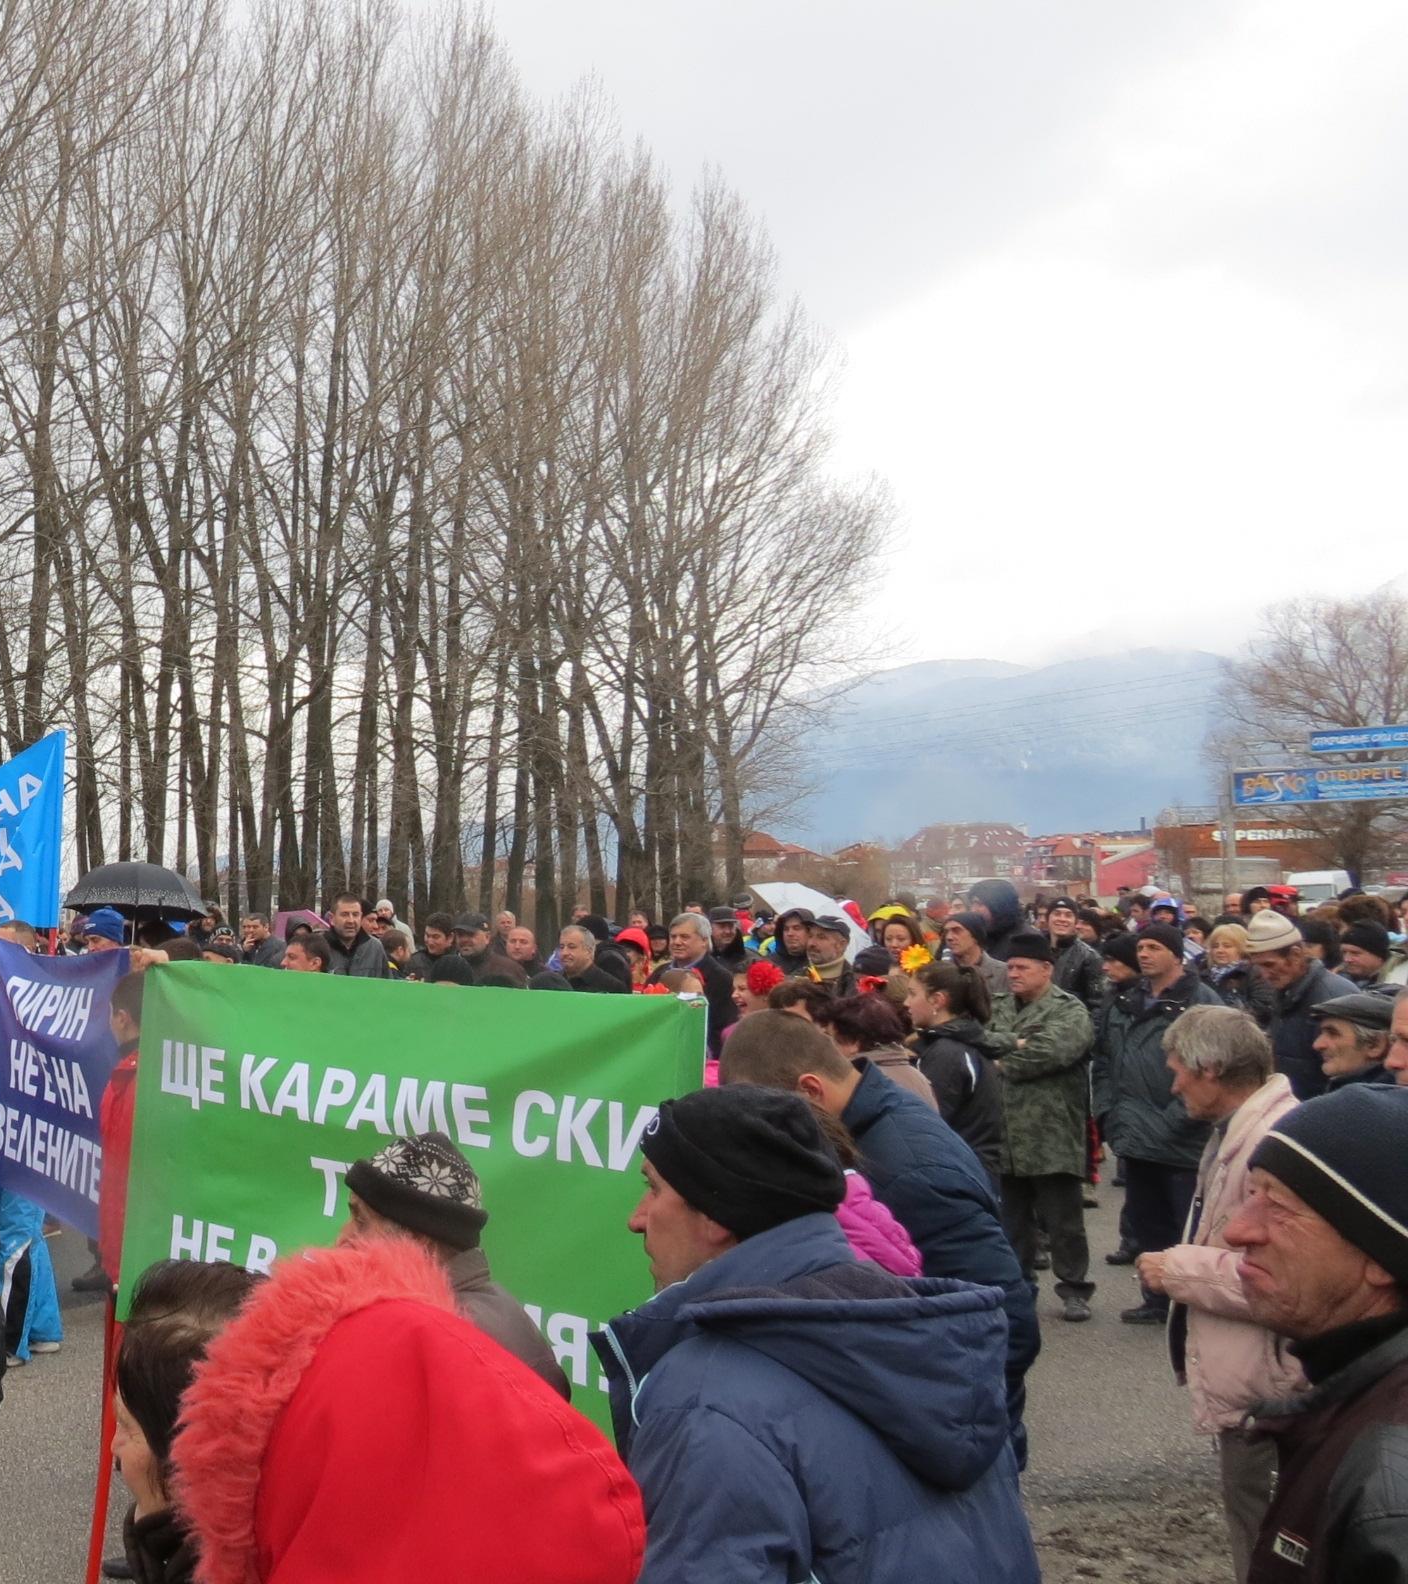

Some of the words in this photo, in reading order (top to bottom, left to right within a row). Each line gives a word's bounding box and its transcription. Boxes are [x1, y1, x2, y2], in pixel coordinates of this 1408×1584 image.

[1315, 767, 1403, 784] ОТВОРЕТЕ
[5, 975, 94, 1042] ПИРИН
[9, 1038, 39, 1098] НЕ
[53, 1056, 94, 1120] НА
[160, 1039, 226, 1110] ЩЕ
[239, 1053, 492, 1149] КАРАМЕ
[510, 1089, 659, 1172] СКИ
[169, 1214, 235, 1264] НЕ
